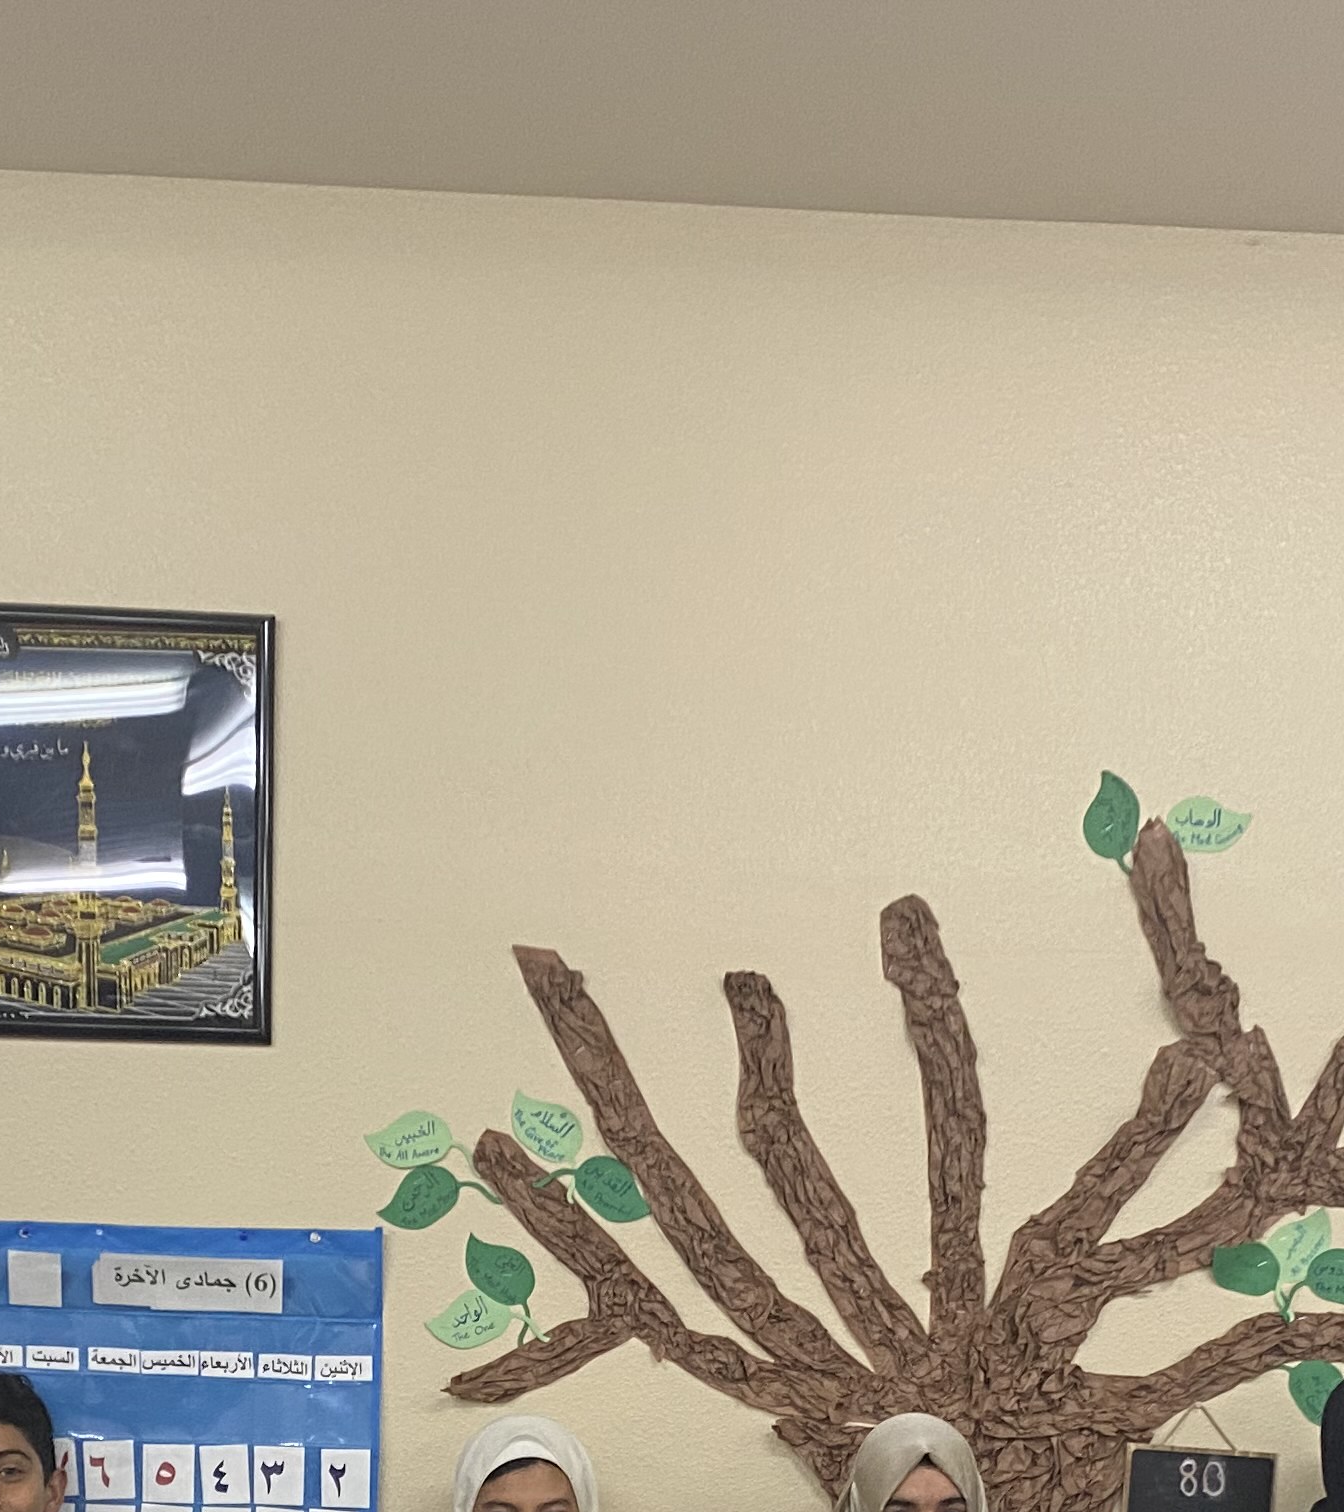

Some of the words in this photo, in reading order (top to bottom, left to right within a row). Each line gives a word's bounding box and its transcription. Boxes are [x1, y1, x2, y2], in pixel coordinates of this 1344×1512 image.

[113, 1265, 168, 1286] الآخرة
[175, 1271, 237, 1295] جمادى
[244, 1273, 278, 1298] (6)
[475, 1323, 495, 1335] One
[32, 1350, 74, 1365] السبت
[91, 1350, 136, 1370] الجمعة
[143, 1352, 195, 1370] الخميس
[201, 1354, 251, 1373] الأربعاء
[262, 1358, 307, 1375] الثلاثاء
[88, 1454, 111, 1488] ٦
[156, 1461, 176, 1486] ٥
[212, 1459, 230, 1494] ٤
[260, 1459, 285, 1495] ٣
[328, 1463, 347, 1497] ٢
[1179, 1458, 1226, 1497] 80
